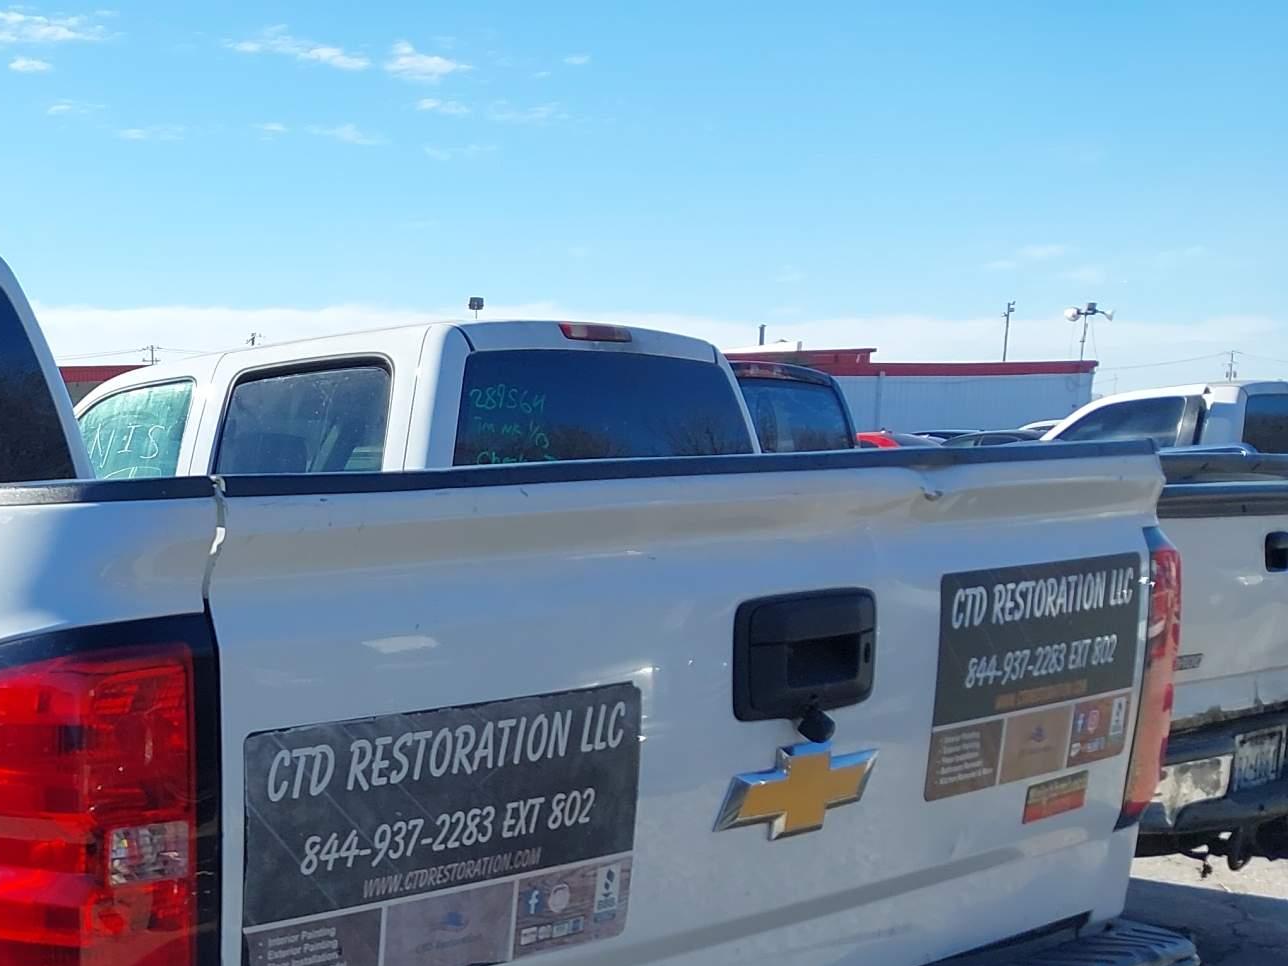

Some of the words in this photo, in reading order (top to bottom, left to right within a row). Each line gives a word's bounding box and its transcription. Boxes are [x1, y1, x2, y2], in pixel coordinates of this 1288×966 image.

[952, 586, 988, 629] CTD
[992, 571, 1106, 625] RESTORATION
[1110, 567, 1134, 606] LLC
[965, 641, 1067, 688] 844-937-2283
[1068, 638, 1092, 670] EXT
[1092, 634, 1118, 665] 802
[267, 744, 335, 802] CTD
[346, 709, 572, 791] RESTORATION
[580, 701, 626, 753] LLC
[300, 806, 495, 875] 844-937-2283
[501, 797, 546, 839] EXT
[547, 787, 596, 831] 802
[362, 848, 543, 899] WWW.CTDRESTORATION.COM
